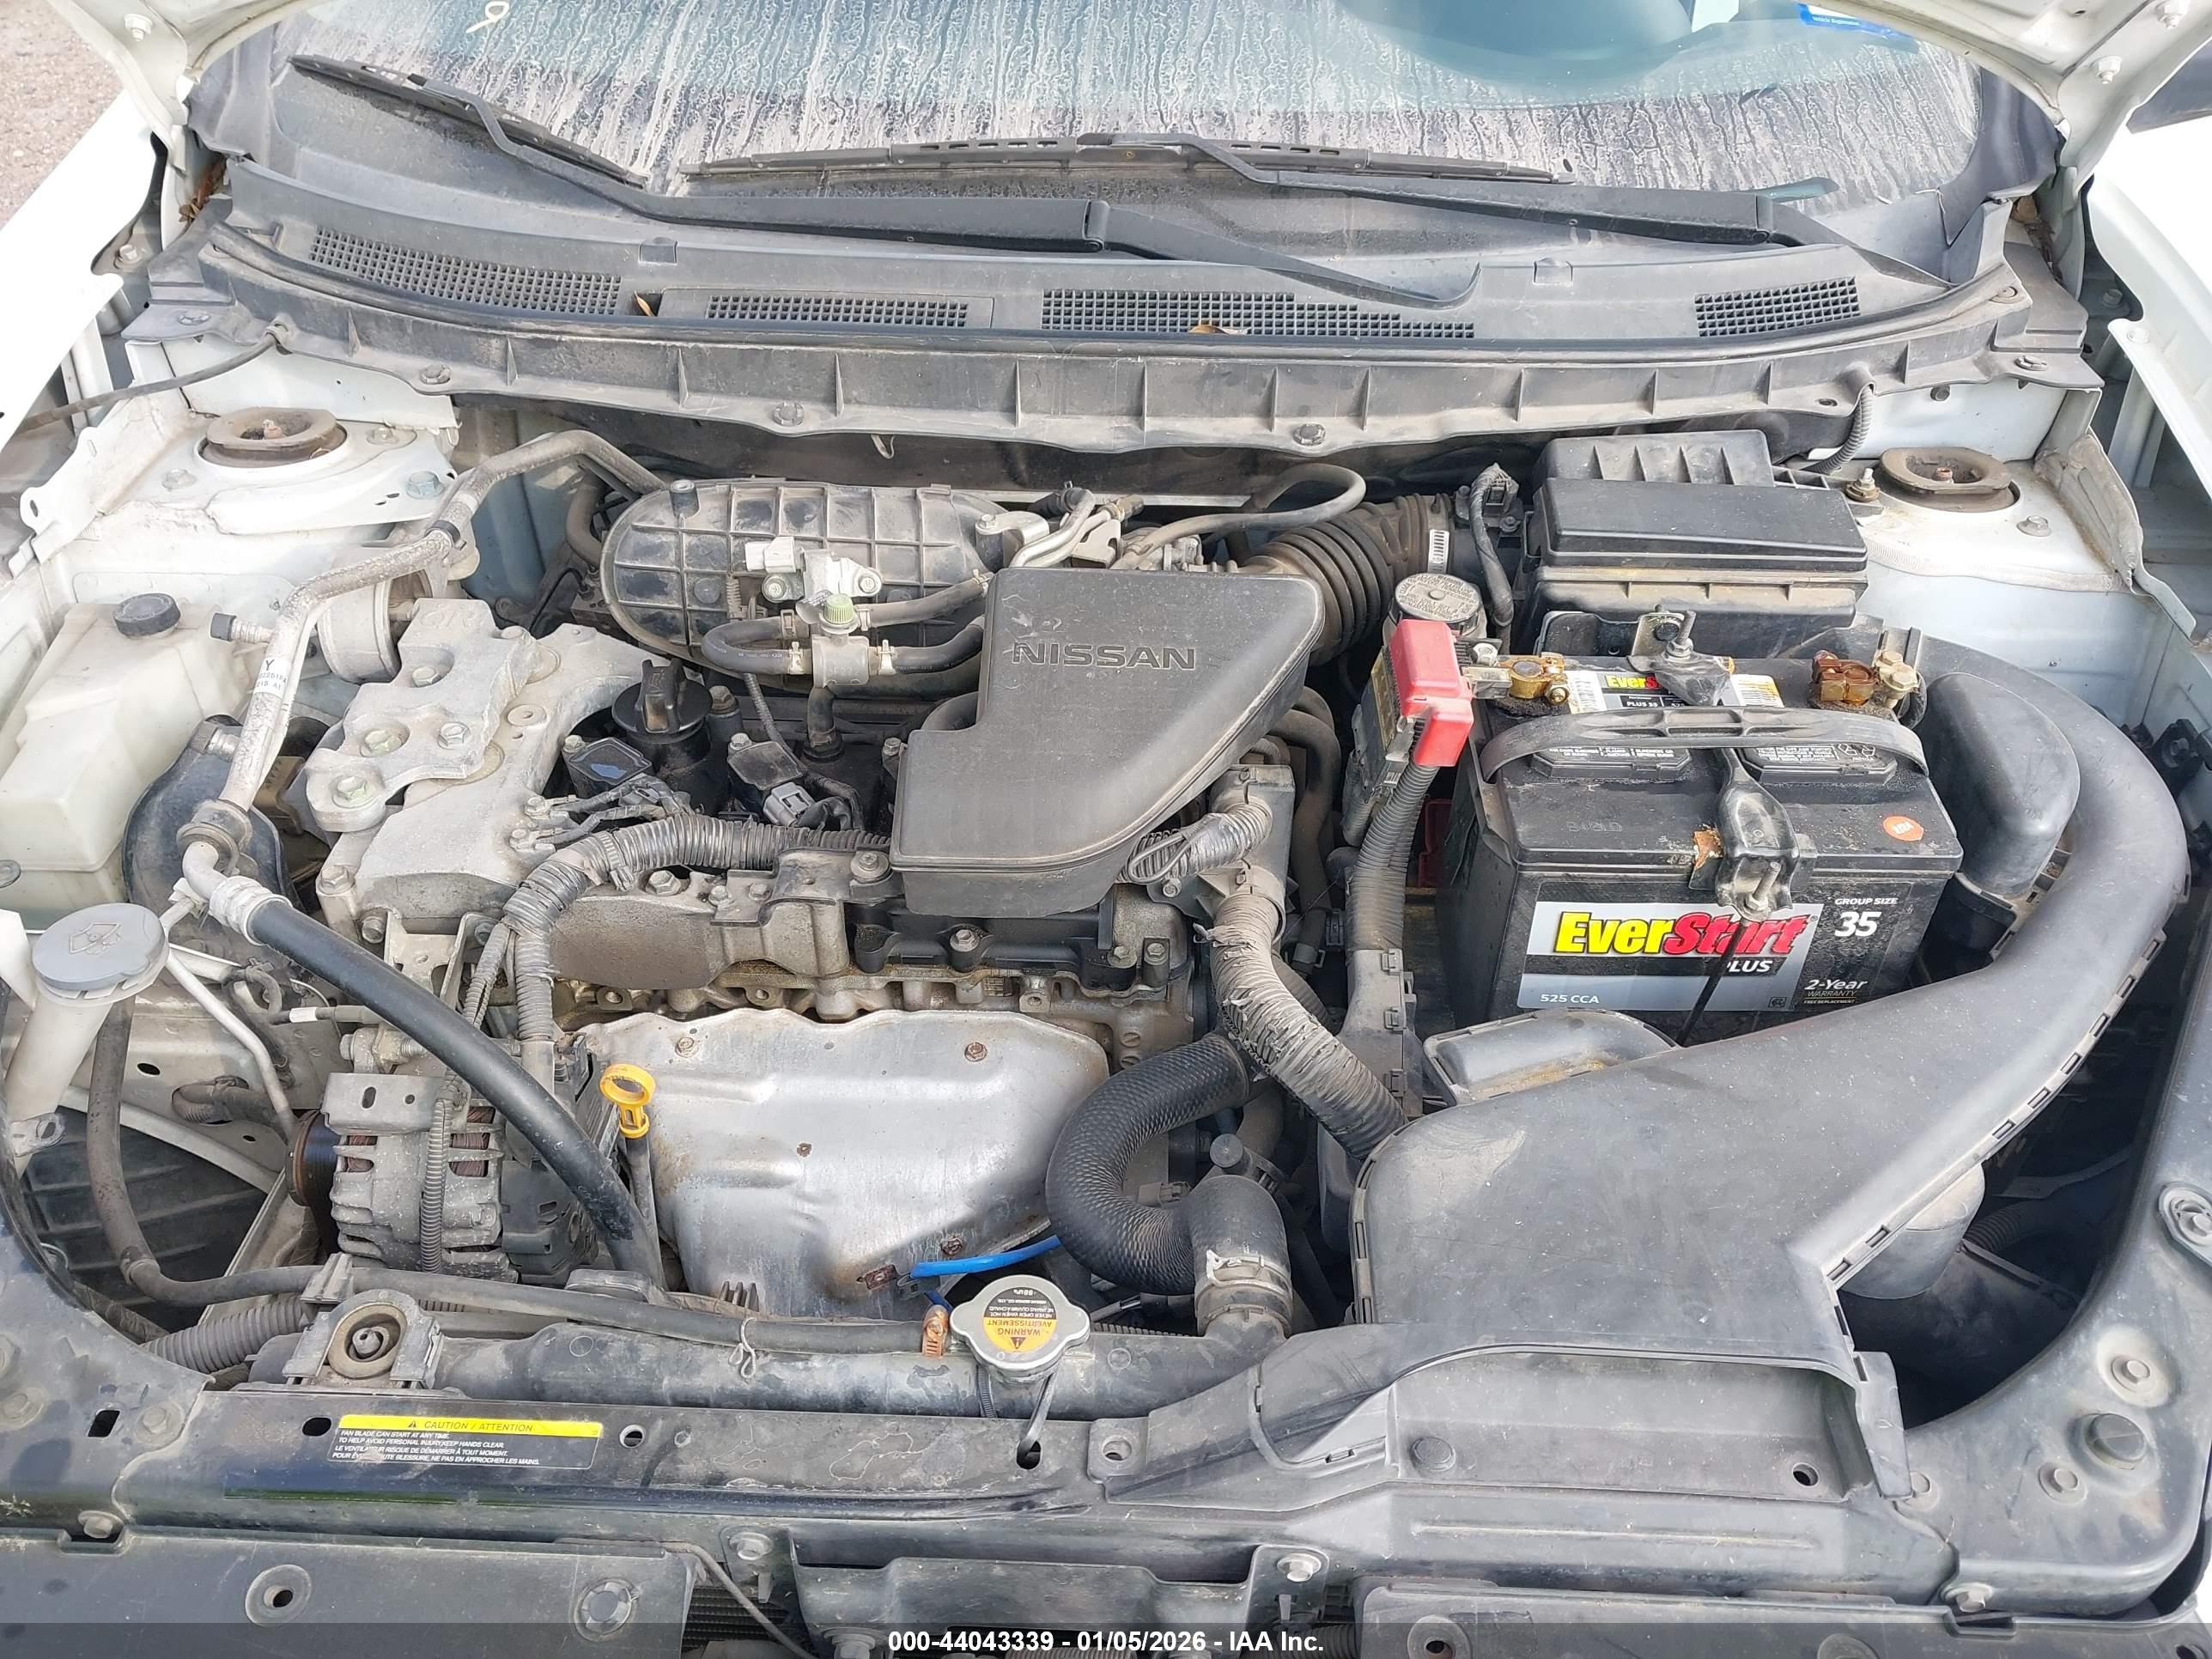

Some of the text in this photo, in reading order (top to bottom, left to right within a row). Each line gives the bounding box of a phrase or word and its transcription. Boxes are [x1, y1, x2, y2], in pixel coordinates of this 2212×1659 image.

[1012, 642, 1195, 670] NISSAN
[265, 659, 275, 671] Y
[1835, 911, 1882, 937] 35
[1804, 979, 1868, 990] 2-Year
[1540, 994, 1600, 1004] 525 CCA
[424, 1420, 469, 1430] CAUTION
[479, 1423, 533, 1431] ATTENTION
[420, 1446, 455, 1455] DÉMARRER
